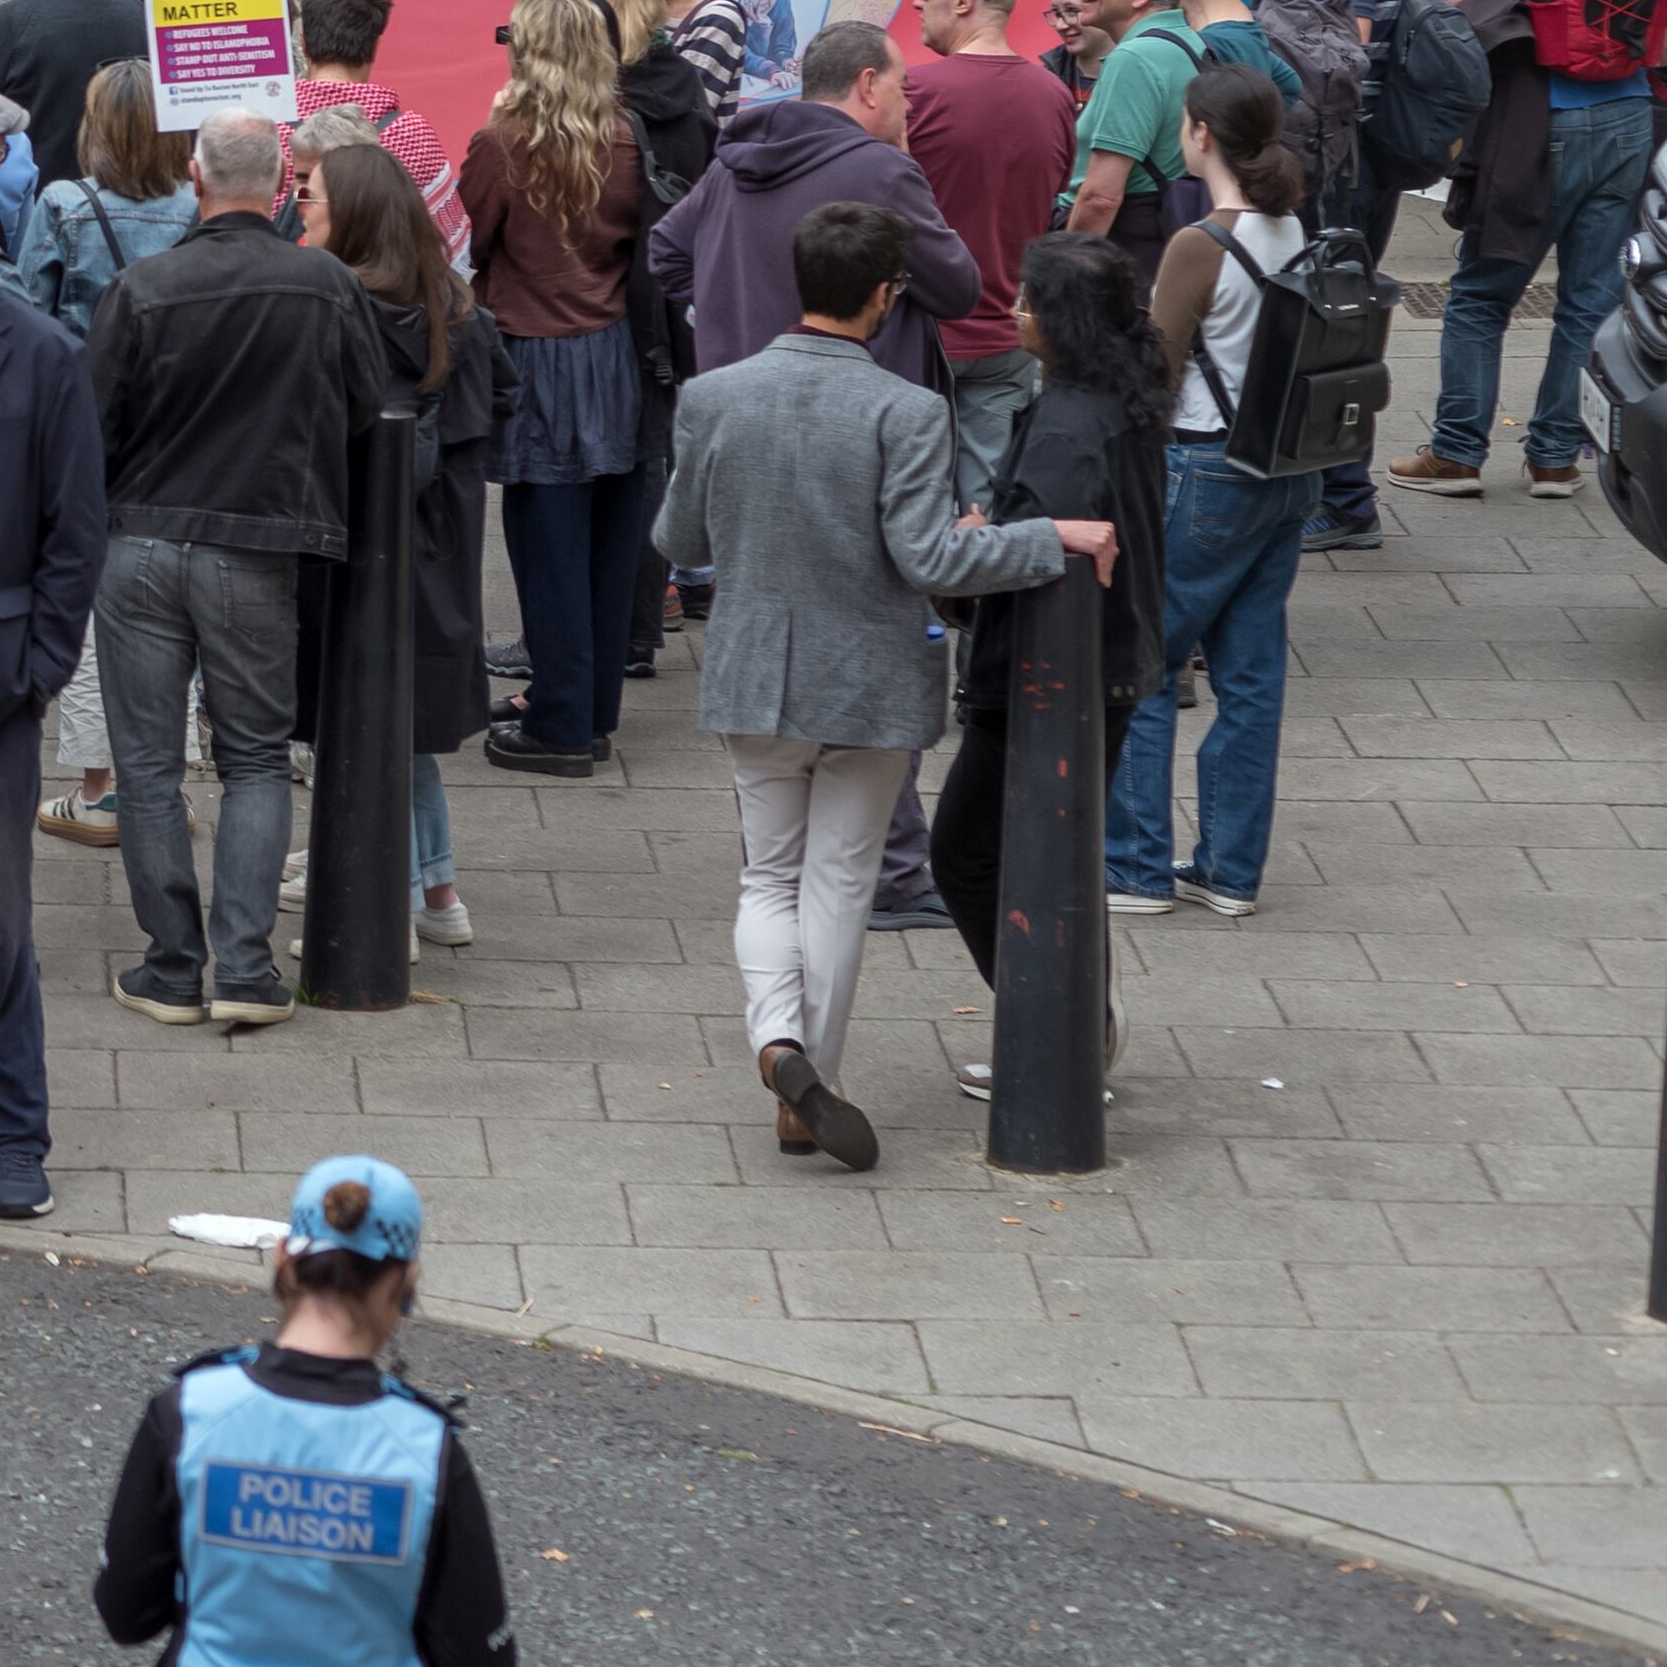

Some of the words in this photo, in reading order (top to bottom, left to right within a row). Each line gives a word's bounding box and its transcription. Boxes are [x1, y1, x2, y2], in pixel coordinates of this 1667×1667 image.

[163, 2, 238, 21] MATTER
[238, 1470, 374, 1518] POLICE
[229, 1508, 375, 1552] LIAISON
